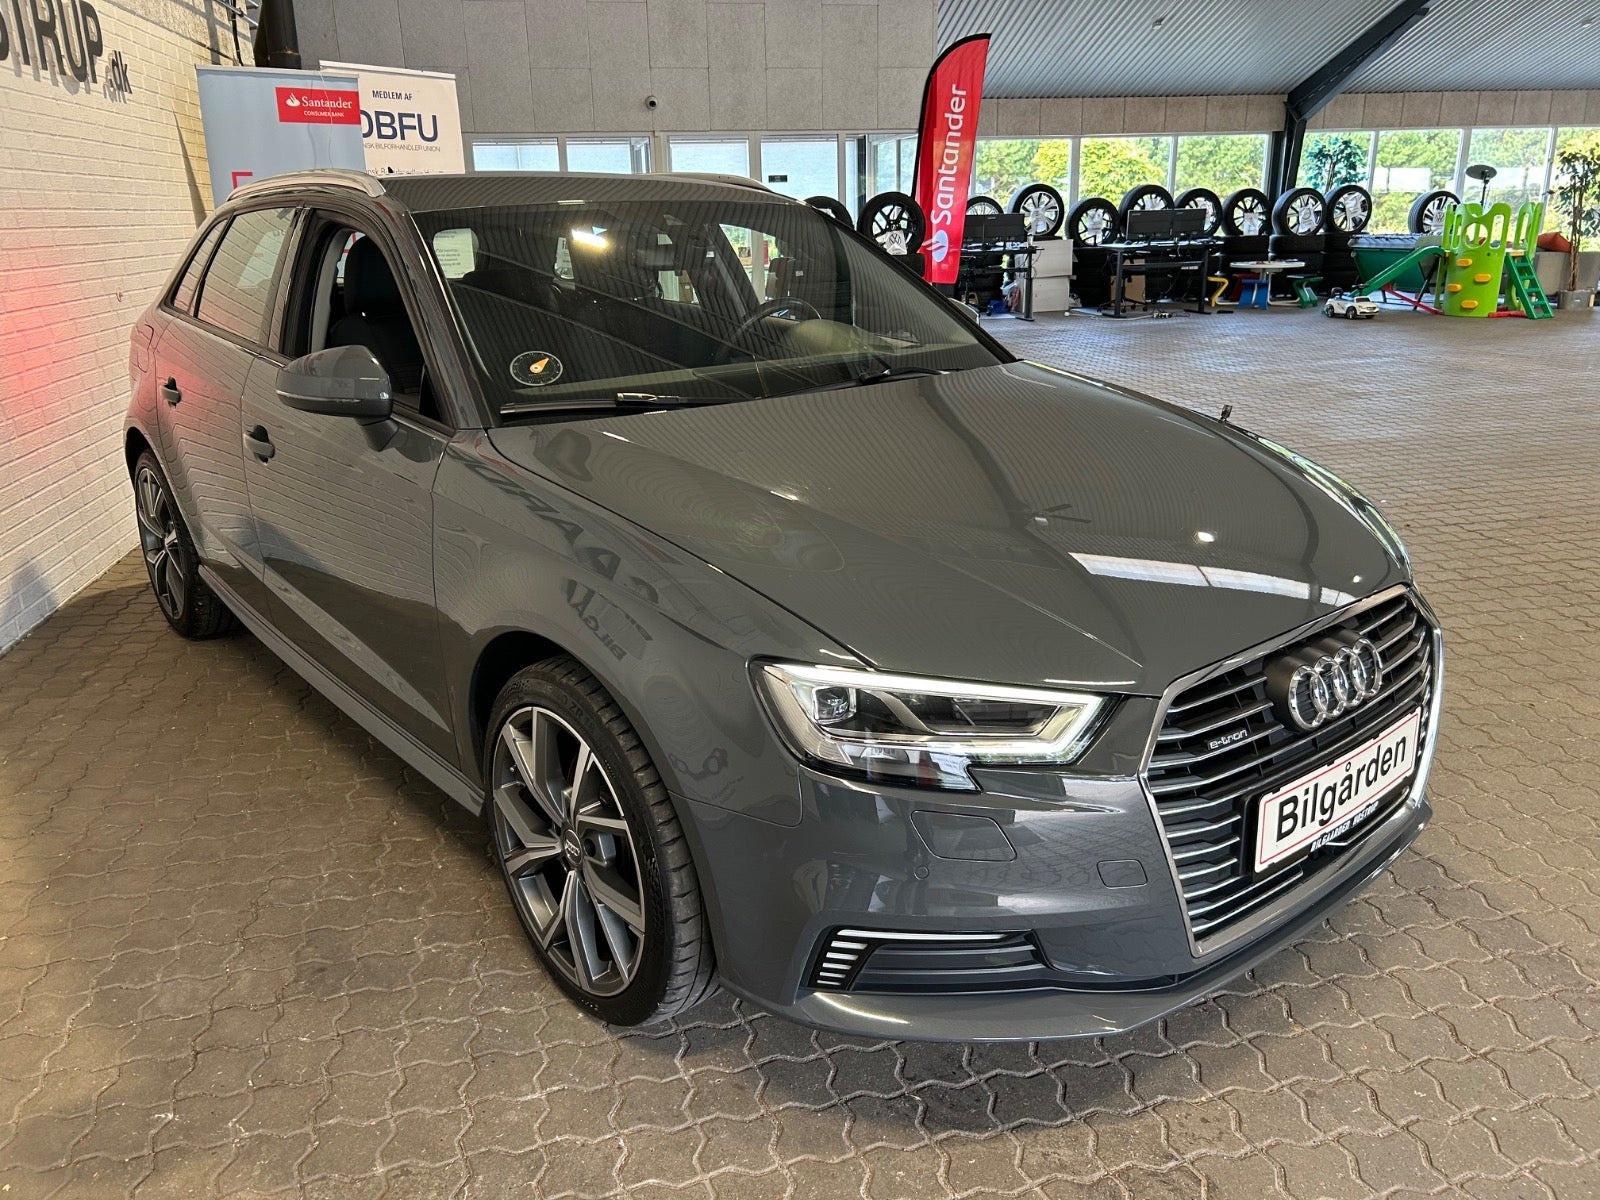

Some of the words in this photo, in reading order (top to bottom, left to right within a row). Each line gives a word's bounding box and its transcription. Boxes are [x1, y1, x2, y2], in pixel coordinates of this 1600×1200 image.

[301, 96, 353, 109] Santander
[372, 90, 403, 100] MEDLEM
[404, 92, 413, 101] AF
[931, 84, 967, 226] Santander
[1209, 729, 1248, 750] e-tron
[1276, 735, 1407, 843] Bilgården
